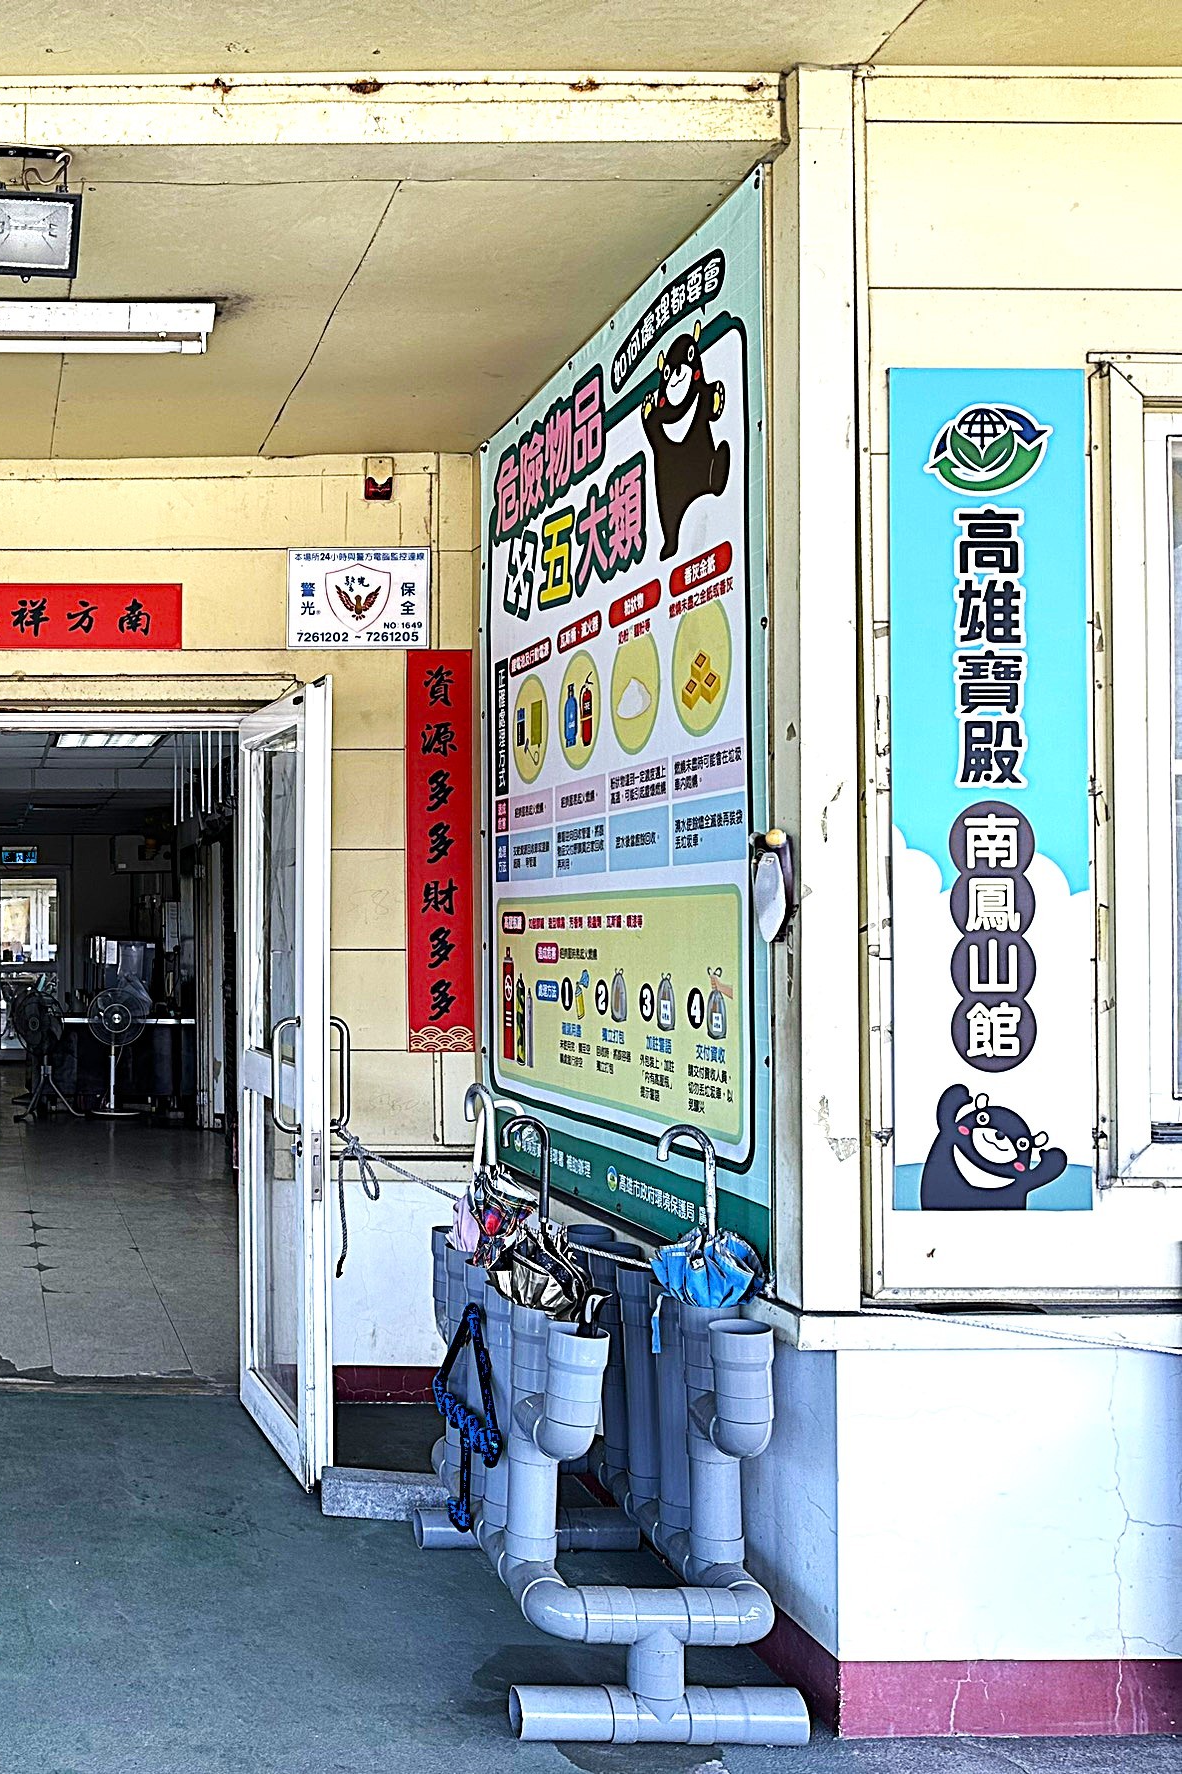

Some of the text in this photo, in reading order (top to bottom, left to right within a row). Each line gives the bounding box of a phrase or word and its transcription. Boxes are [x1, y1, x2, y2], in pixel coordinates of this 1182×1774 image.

[494, 372, 604, 537] 危險物品
[539, 464, 642, 605] 五大類
[683, 553, 716, 585] 香灰金紙
[400, 582, 416, 616] 保全
[297, 632, 349, 643] 7261202
[366, 632, 419, 643] 7261205
[957, 507, 1023, 785] 高雄寶殿
[420, 664, 458, 1021] 資源多多財多多
[963, 813, 1022, 1059] 南鳳山館
[597, 984, 606, 1011] 2
[642, 987, 652, 1017] 3
[690, 993, 702, 1024] 4
[618, 1173, 696, 1223] 高雄市政府環境保護局
